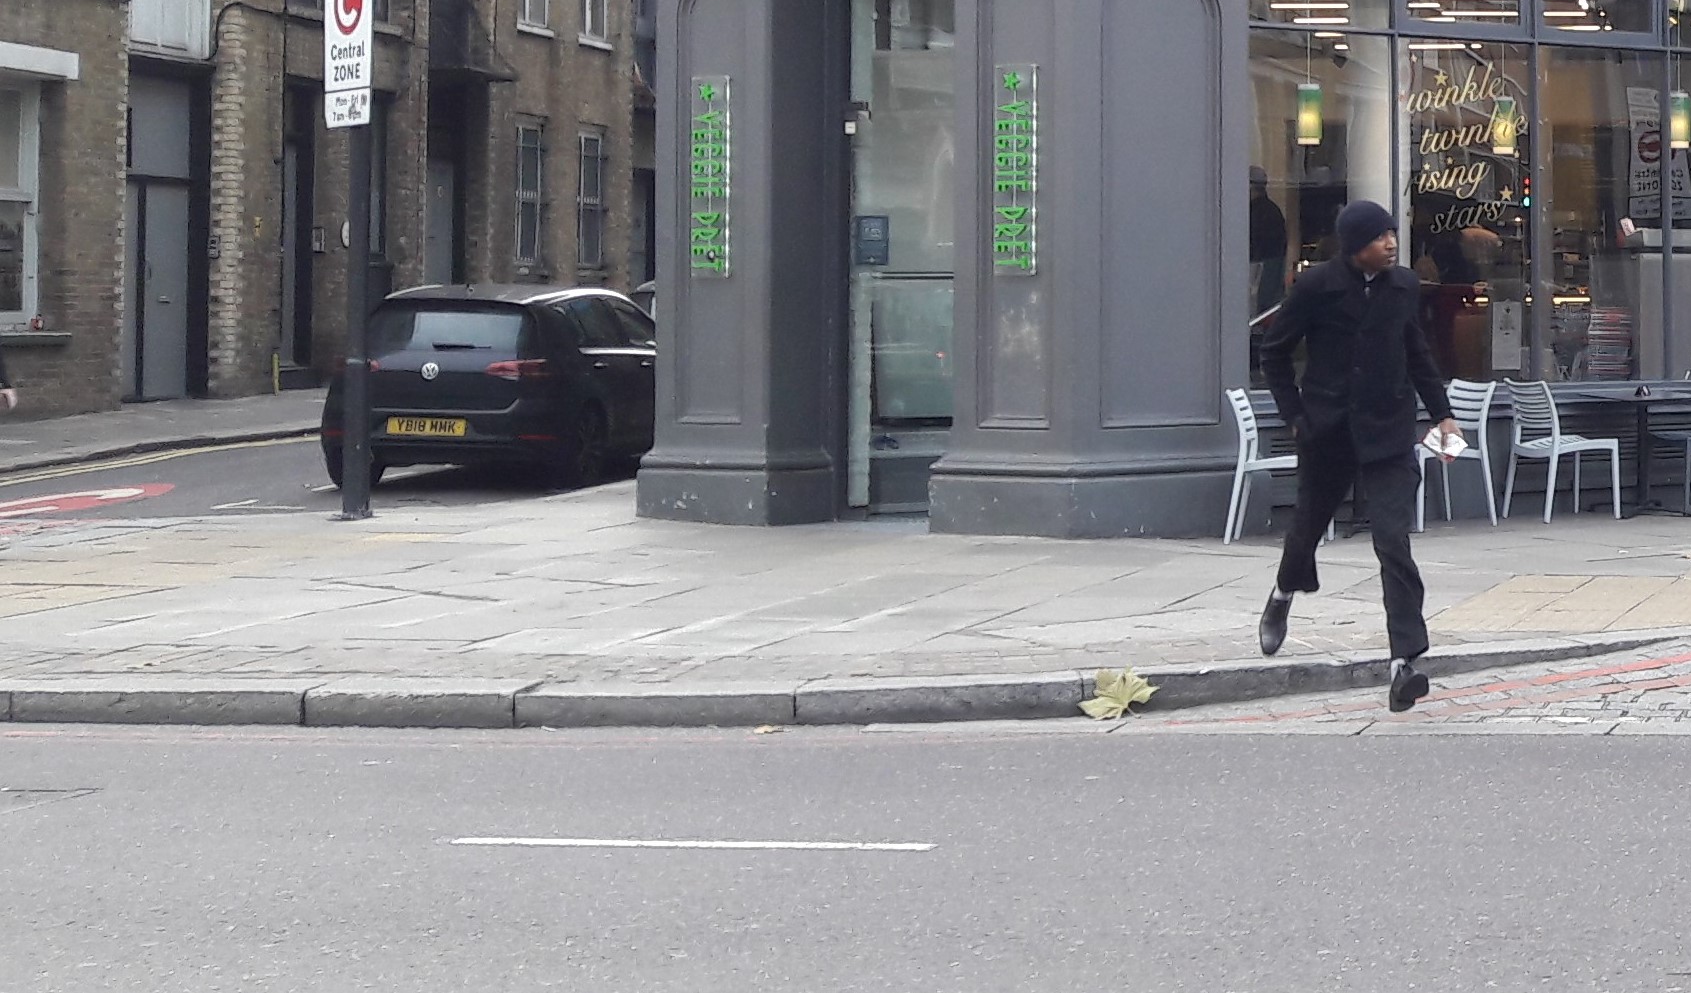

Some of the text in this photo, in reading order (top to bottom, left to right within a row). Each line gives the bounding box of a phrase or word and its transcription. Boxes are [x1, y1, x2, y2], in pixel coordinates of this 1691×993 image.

[330, 39, 366, 61] Central
[333, 63, 361, 82] ZONE
[692, 109, 725, 198] VEGGIE
[993, 100, 1032, 270] VEGGIE PRET
[1430, 199, 1509, 235] stars
